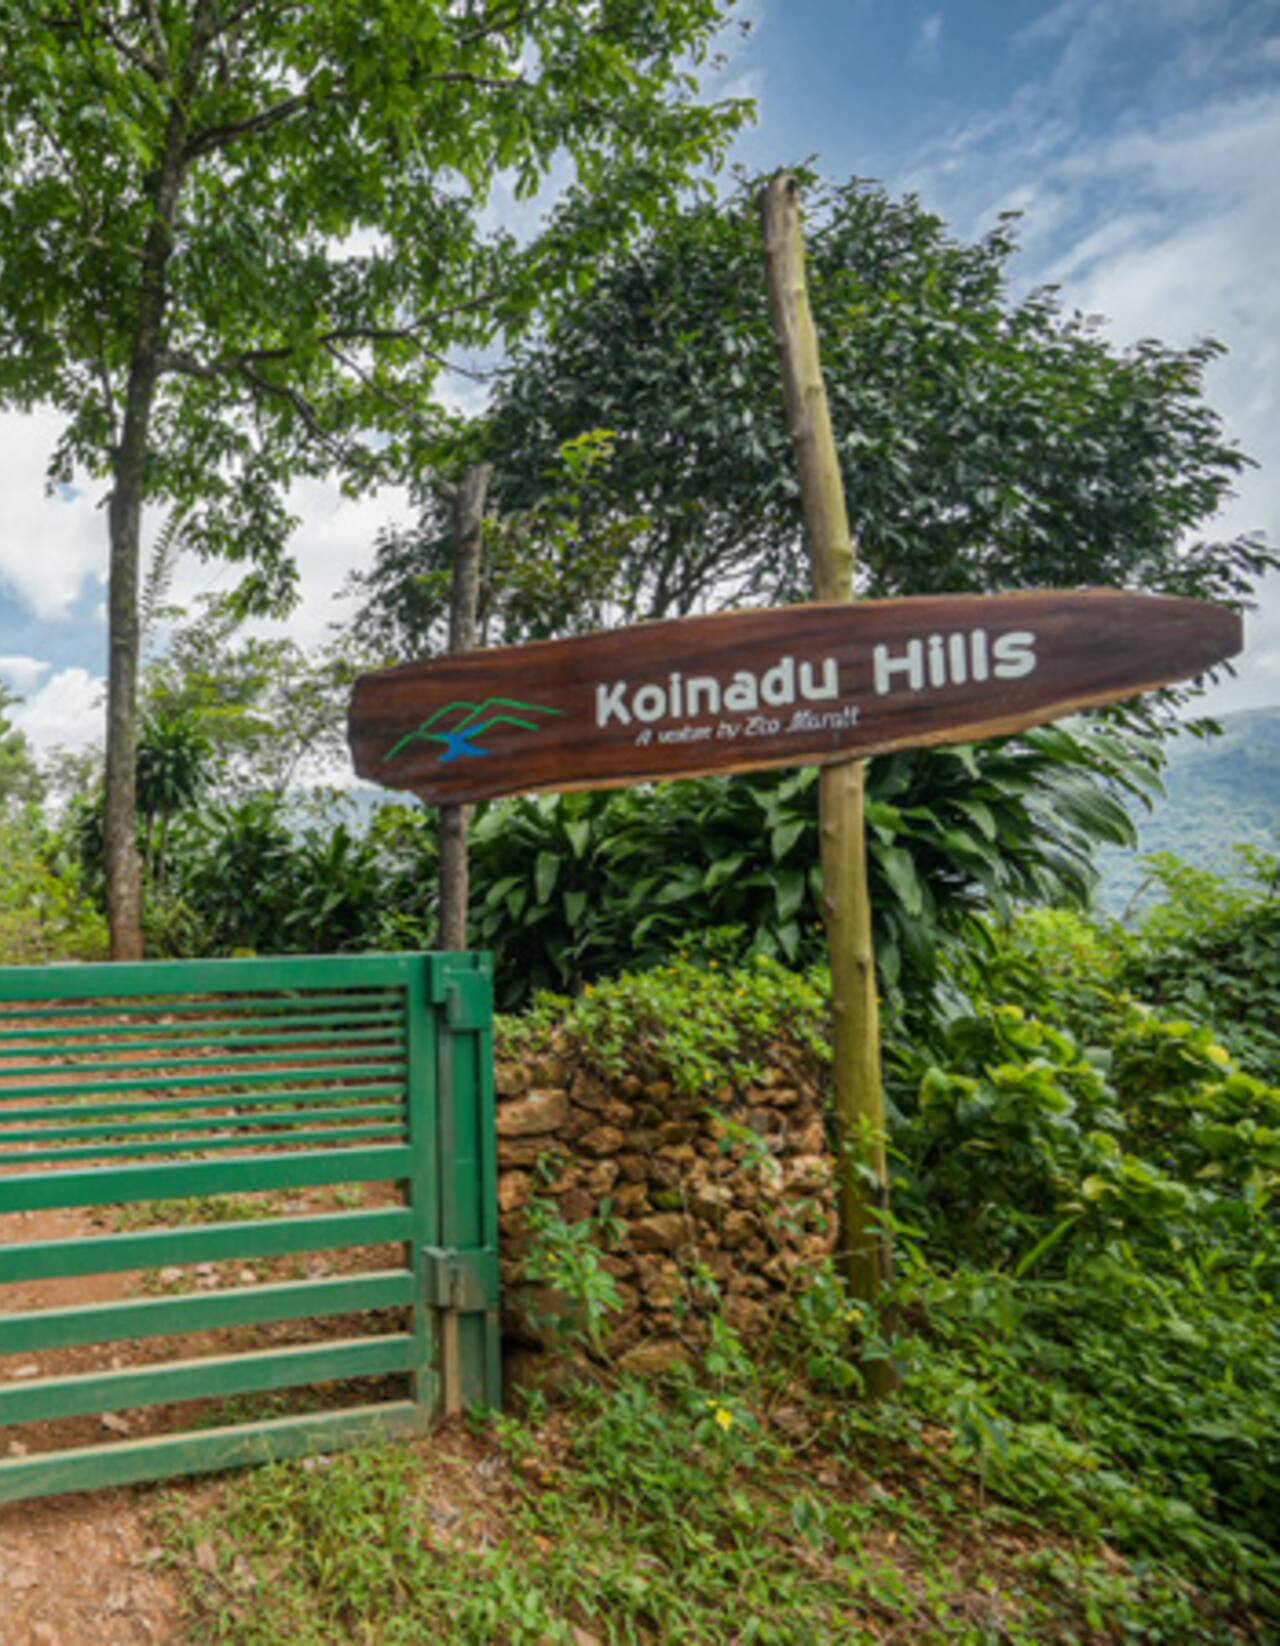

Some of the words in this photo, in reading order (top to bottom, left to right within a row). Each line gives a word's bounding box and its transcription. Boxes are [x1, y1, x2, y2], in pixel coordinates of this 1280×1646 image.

[594, 656, 840, 728] Koinadu
[872, 628, 1038, 696] Hills
[716, 719, 743, 740] by
